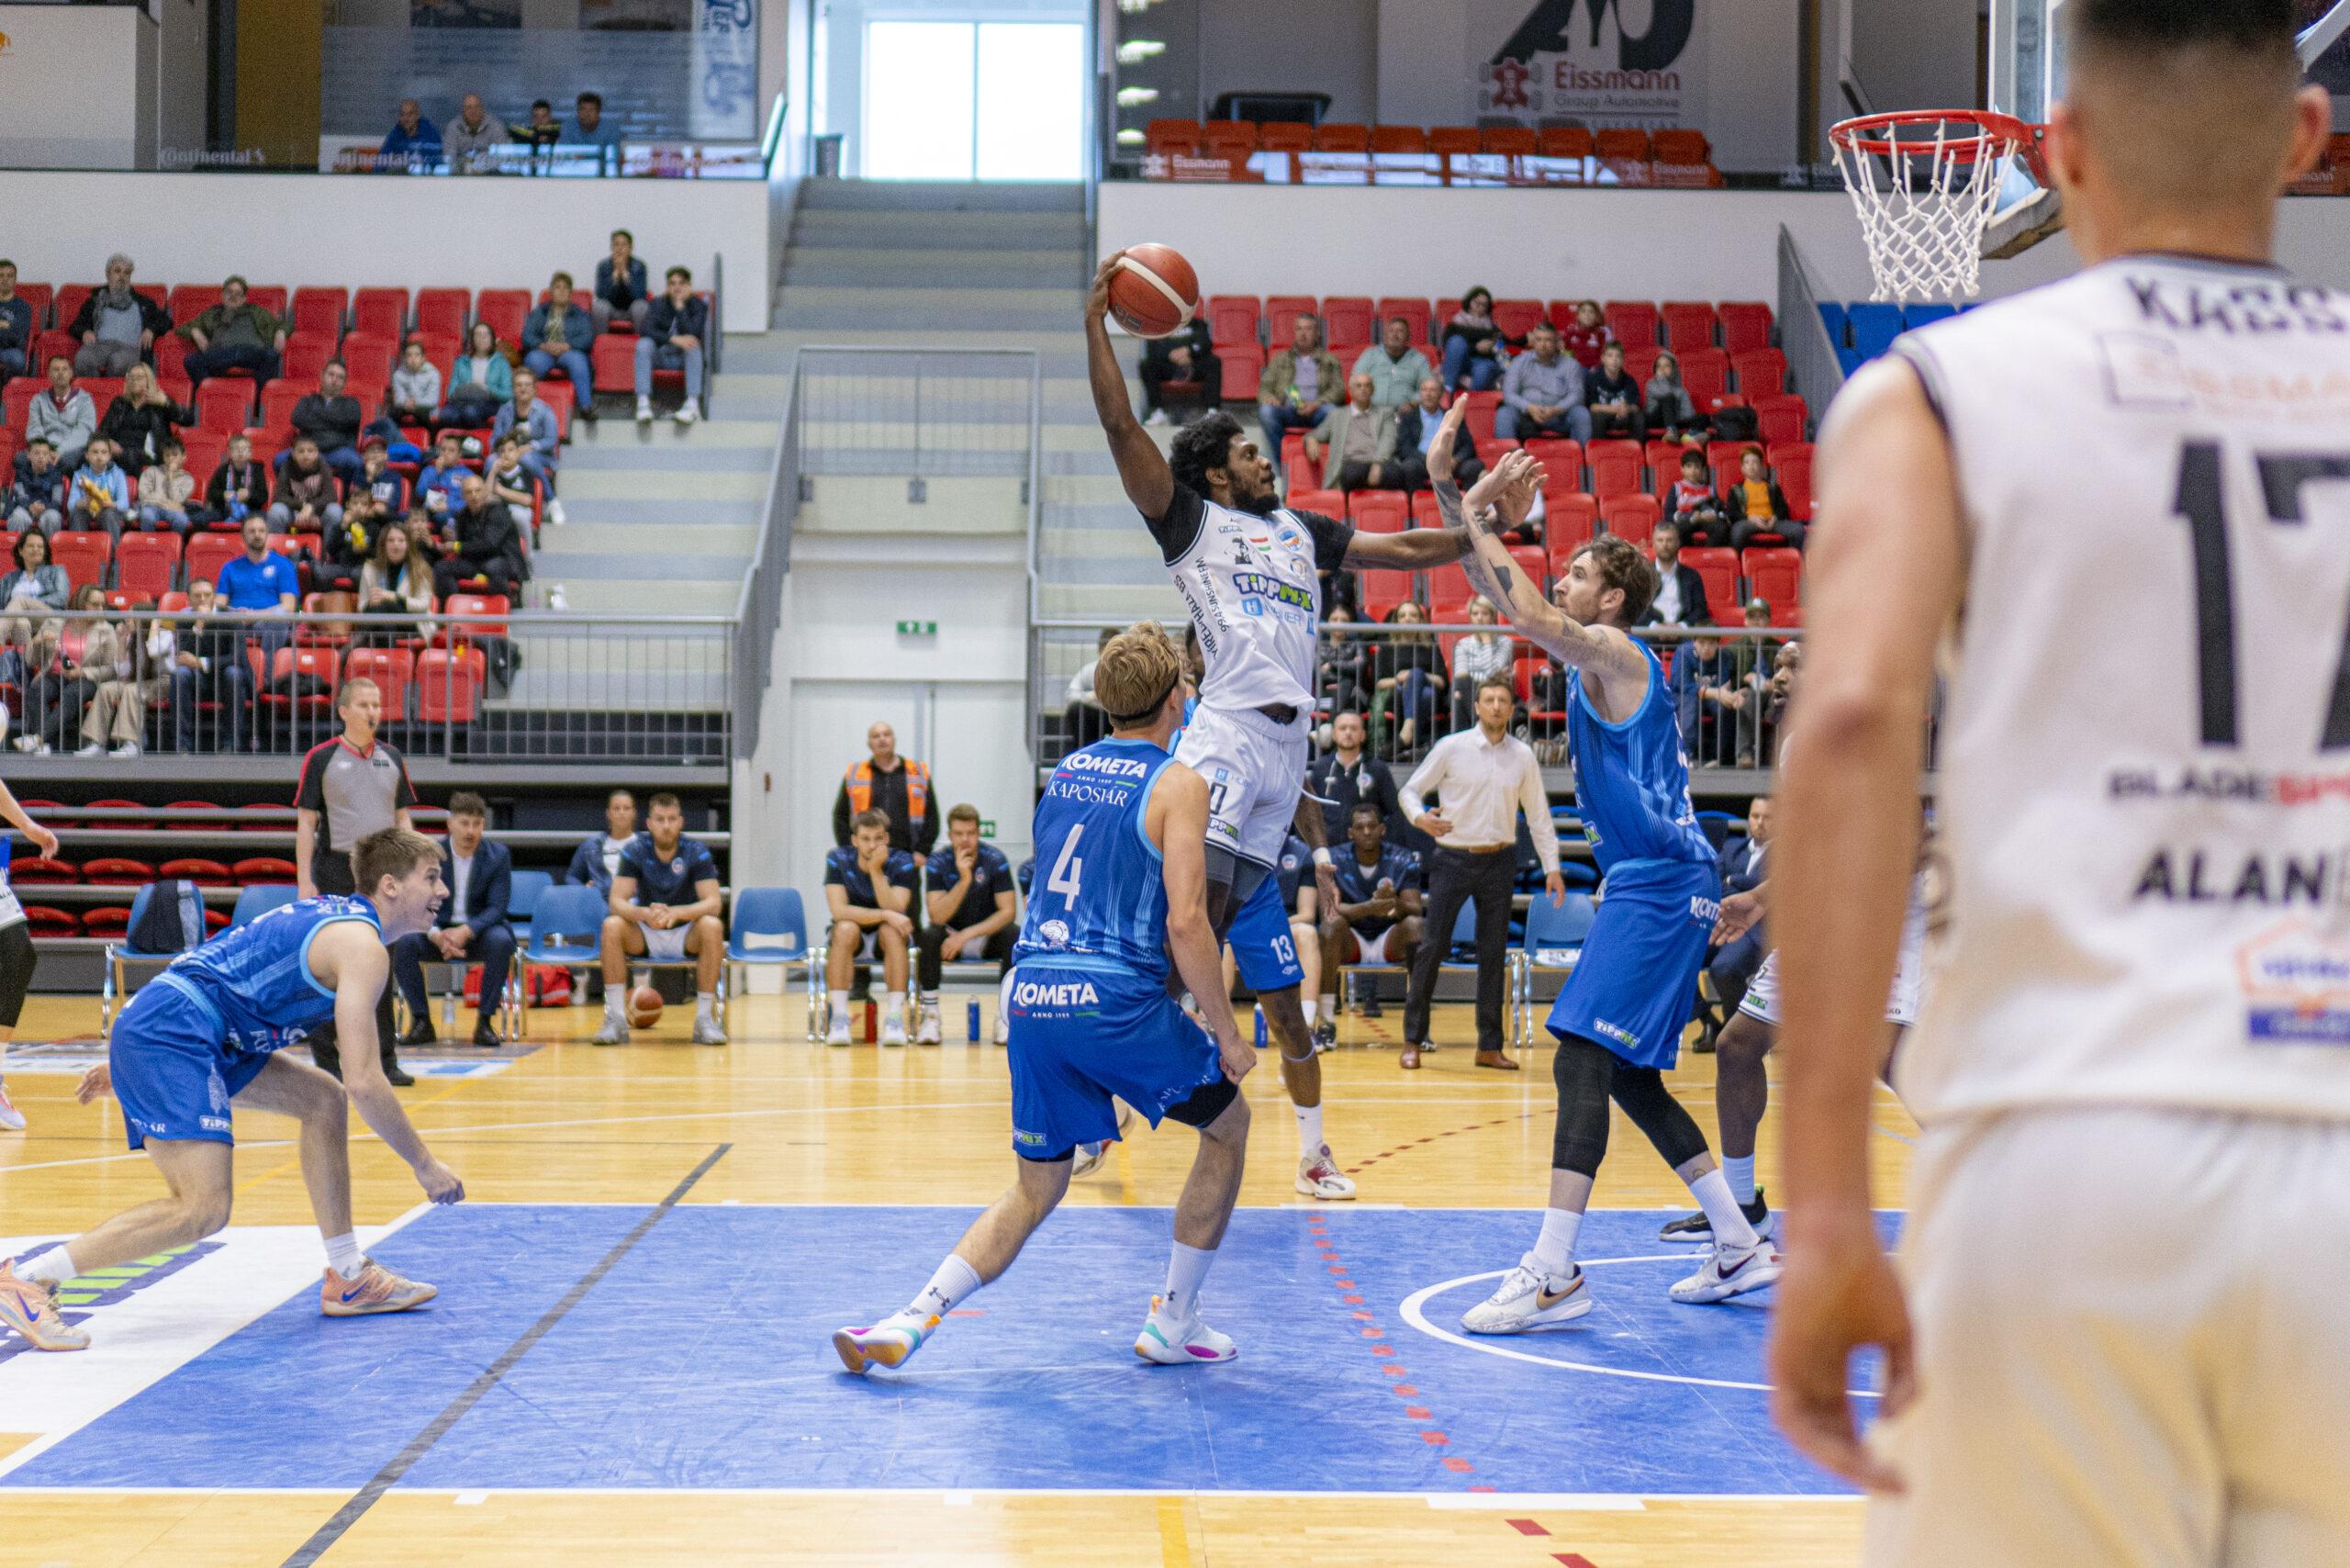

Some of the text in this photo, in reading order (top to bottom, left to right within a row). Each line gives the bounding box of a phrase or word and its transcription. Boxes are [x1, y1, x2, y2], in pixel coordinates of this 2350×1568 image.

[1555, 61, 1681, 90] Eissmann
[1555, 94, 1680, 109] Group Automotive
[1061, 753, 1147, 778] KOMETA
[1047, 823, 1085, 911] 4
[1270, 935, 1293, 964] 13
[1013, 982, 1099, 1007] KOMETA
